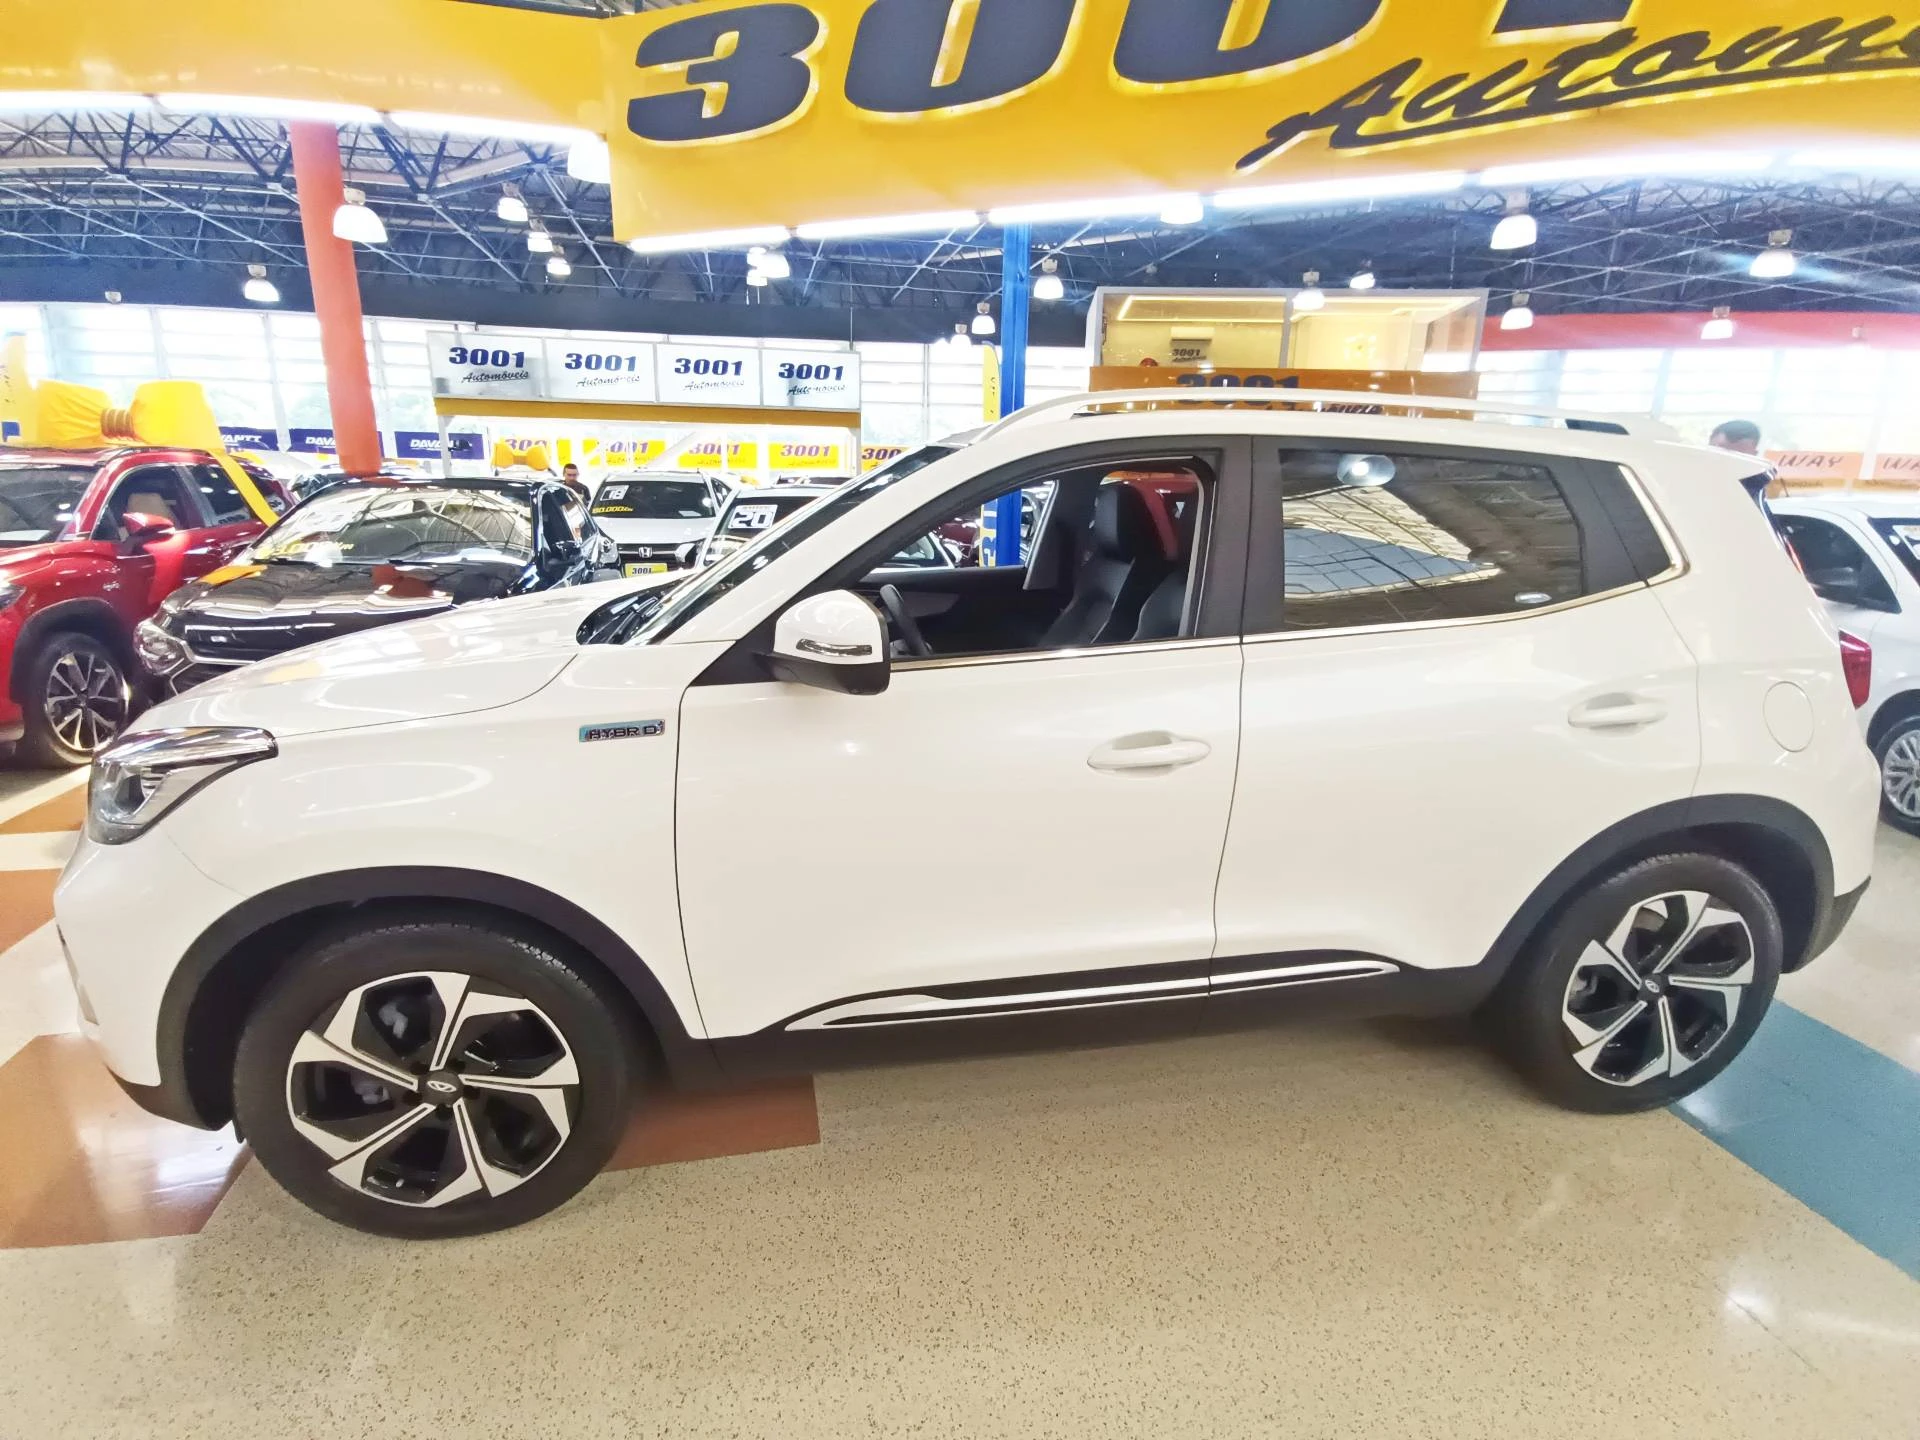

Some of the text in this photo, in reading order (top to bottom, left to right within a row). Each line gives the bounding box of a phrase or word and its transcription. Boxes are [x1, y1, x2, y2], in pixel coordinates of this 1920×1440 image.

[627, 0, 1634, 141] 300
[1235, 15, 1920, 169] Autom
[449, 346, 525, 369] 3001
[565, 352, 637, 371] 3001
[674, 357, 743, 376] 3001
[778, 362, 844, 381] 3001
[781, 444, 830, 457] 3001
[732, 511, 772, 528] 20
